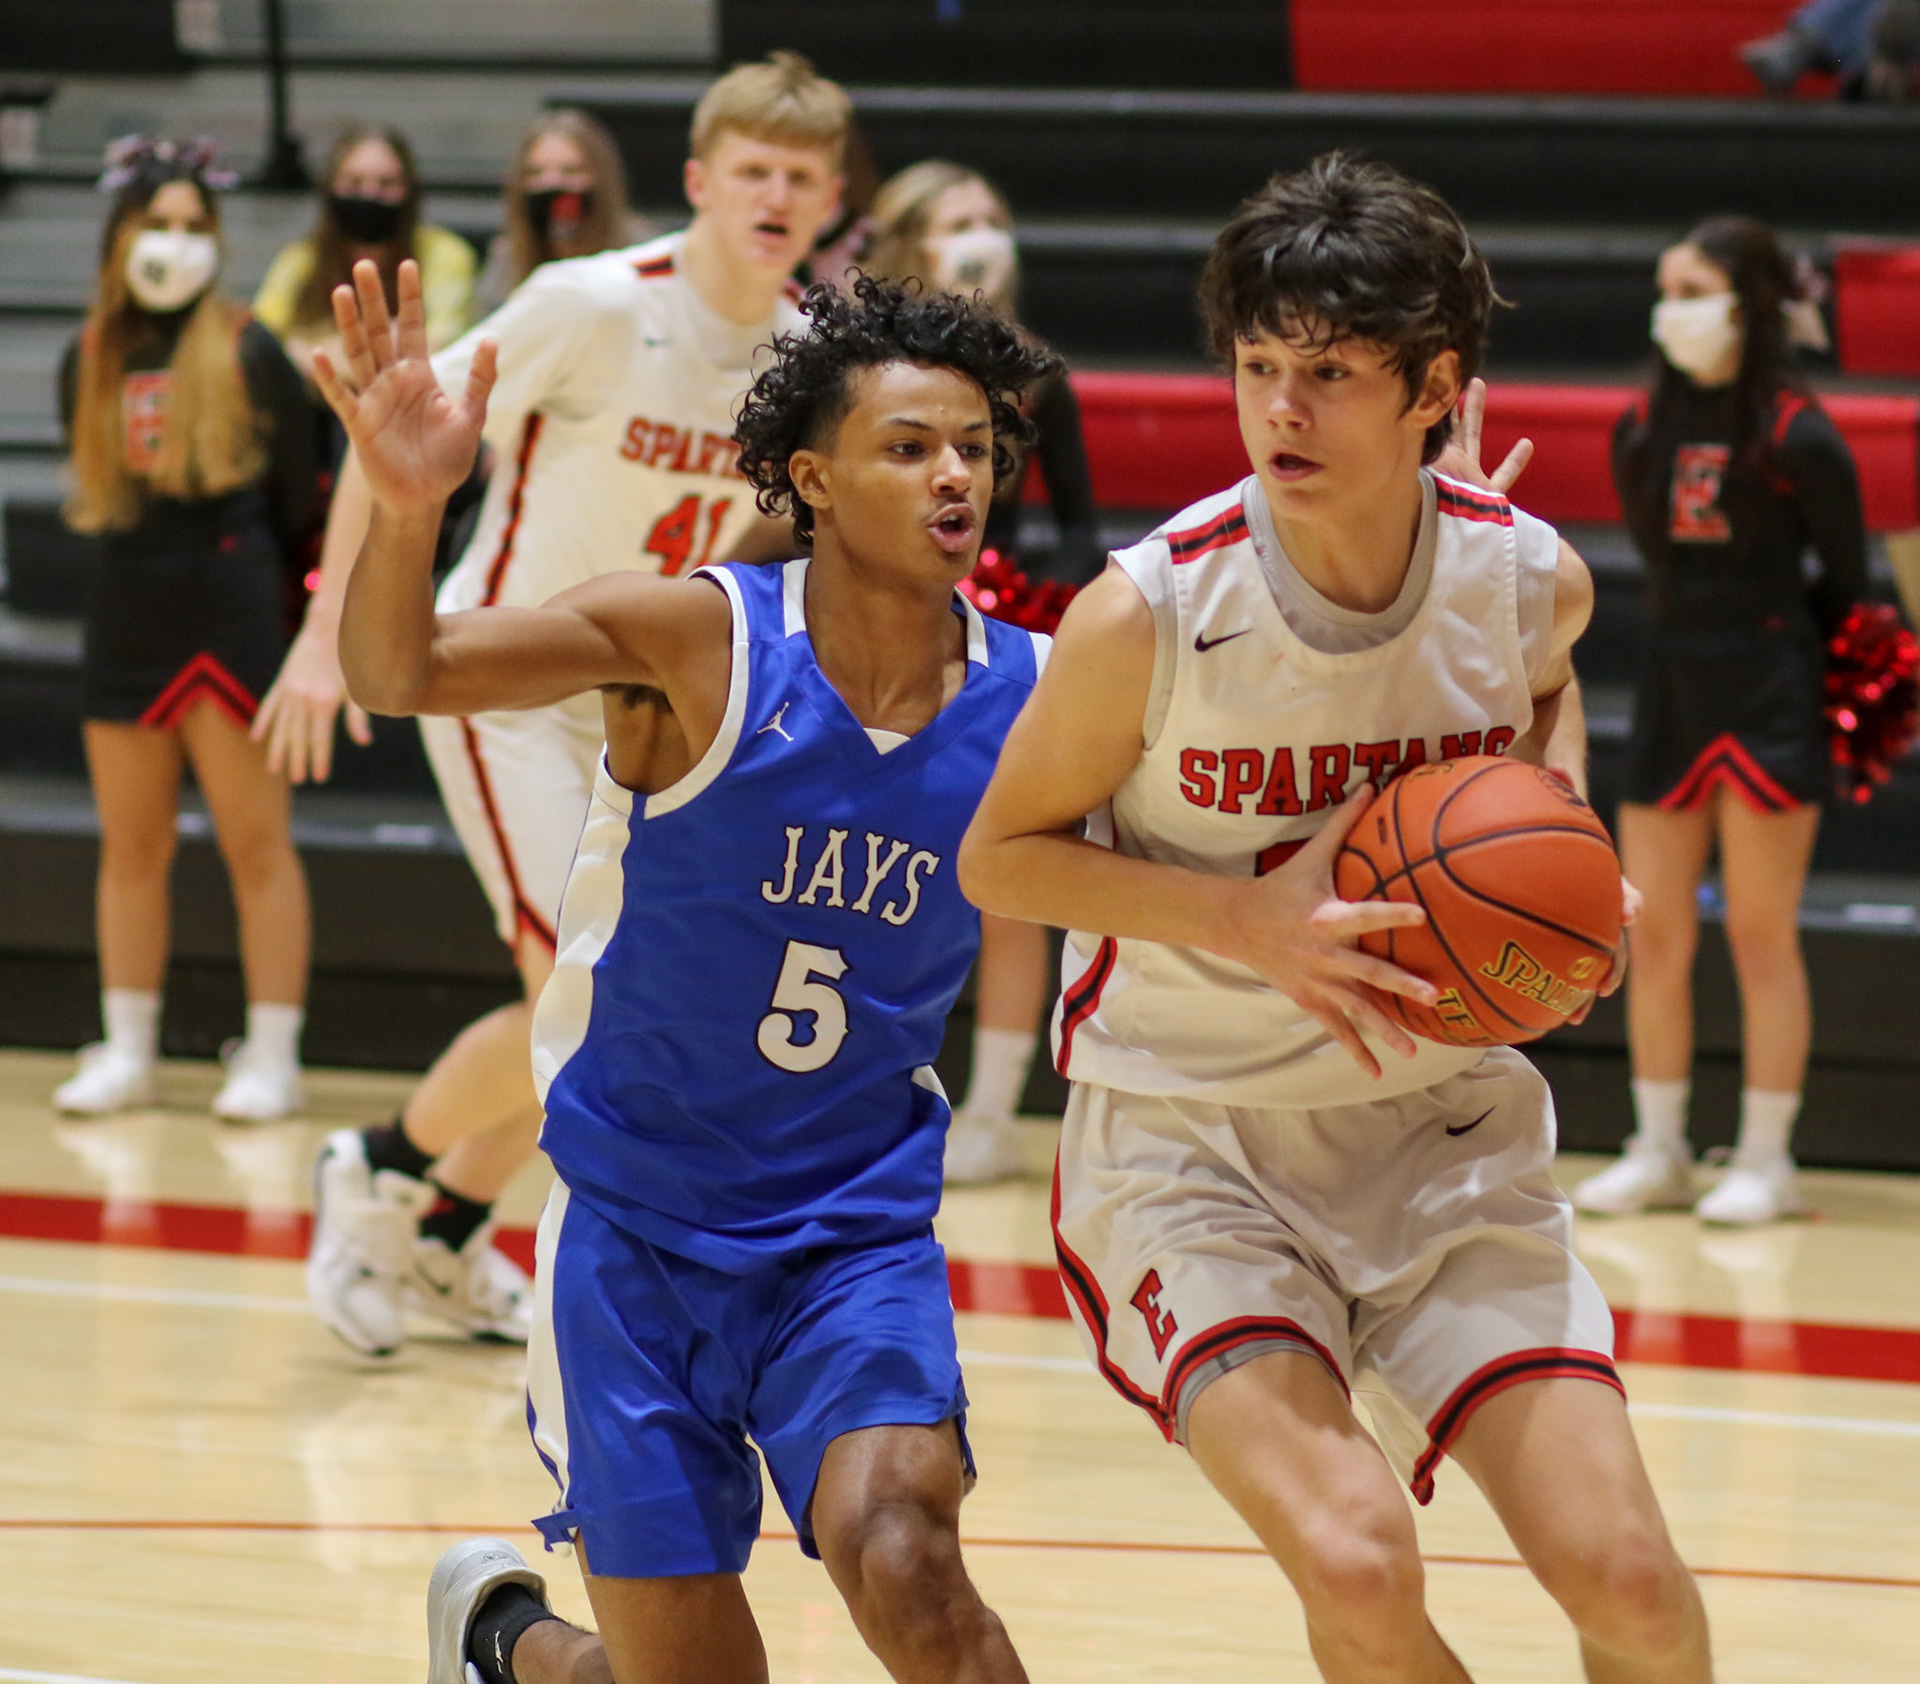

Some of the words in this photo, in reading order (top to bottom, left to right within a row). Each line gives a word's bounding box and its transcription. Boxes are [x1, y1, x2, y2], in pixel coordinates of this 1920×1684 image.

[641, 493, 734, 578] 41
[1669, 444, 1733, 543] E
[760, 825, 941, 927] JAYS
[755, 937, 853, 1074] 5
[1128, 1267, 1179, 1364] E
